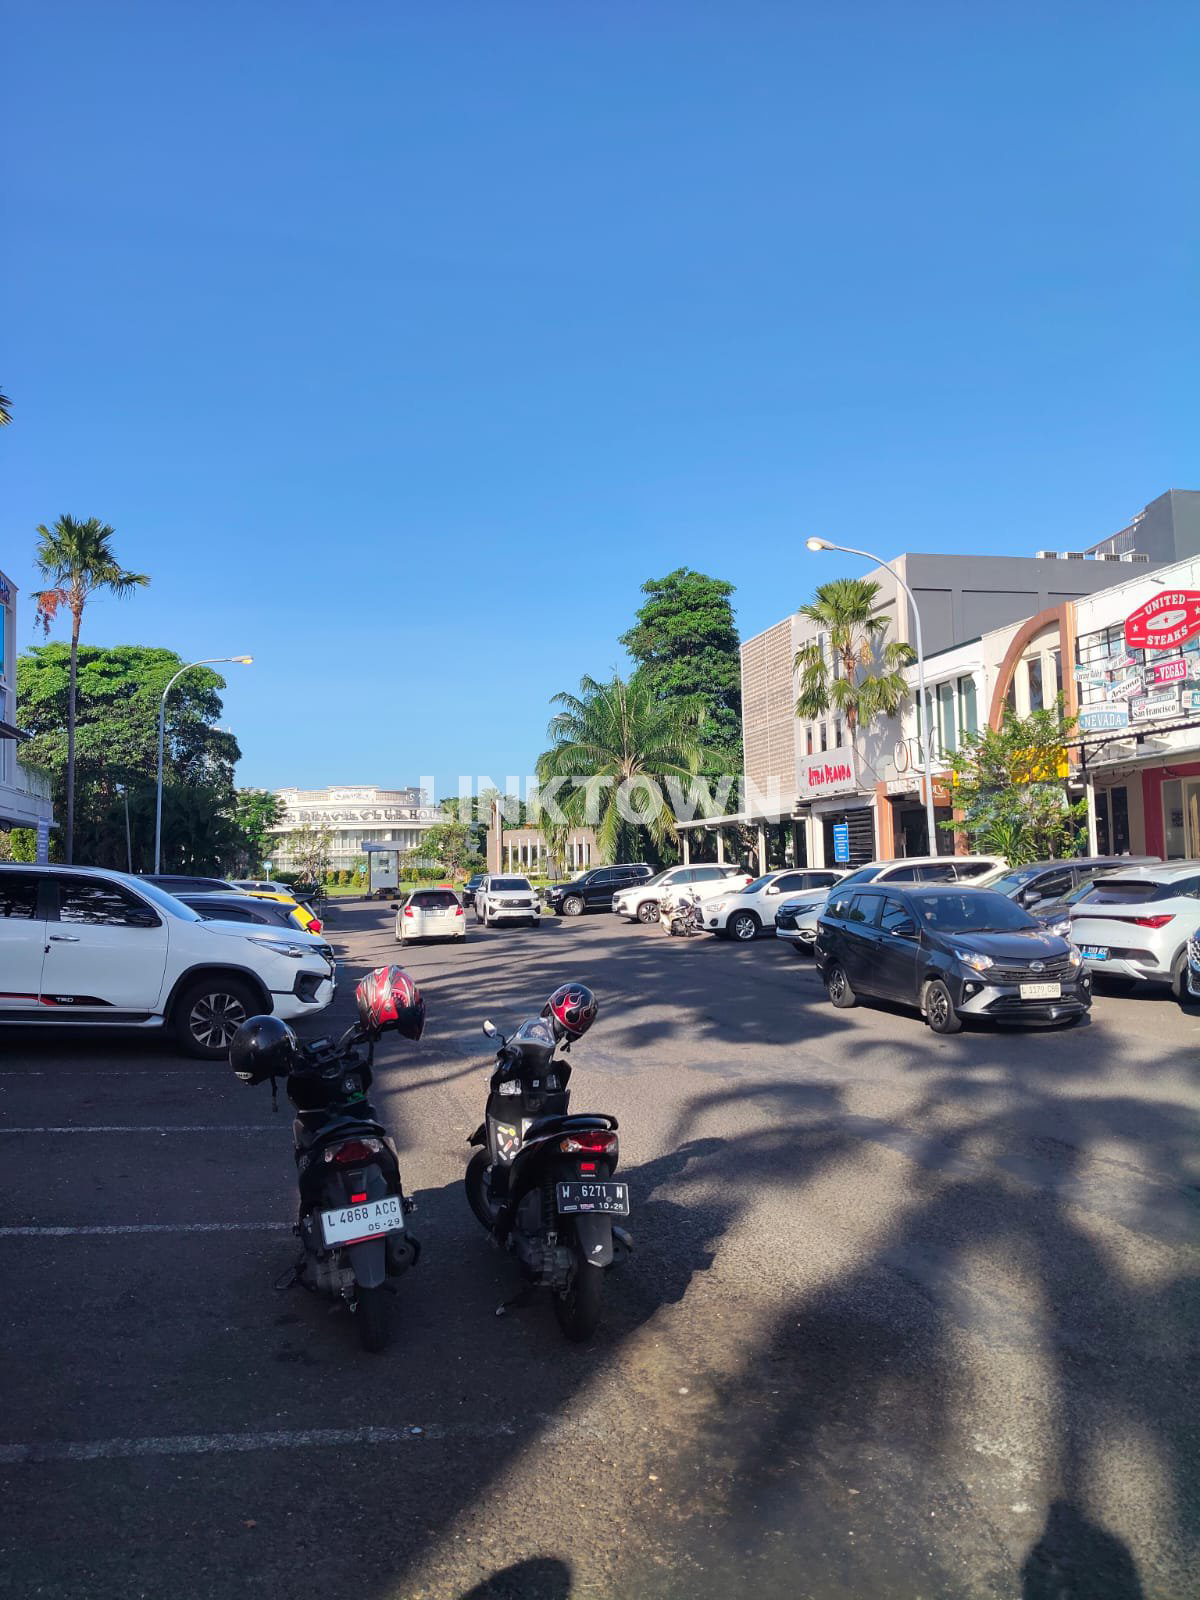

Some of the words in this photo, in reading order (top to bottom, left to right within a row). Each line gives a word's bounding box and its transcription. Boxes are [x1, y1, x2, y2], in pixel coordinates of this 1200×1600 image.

[1144, 594, 1186, 615] UNITED
[1147, 625, 1188, 645] STEAKS
[1160, 662, 1185, 681] VEGAS
[1084, 713, 1122, 728] NEVADA
[562, 1185, 570, 1198] W
[581, 1185, 607, 1198] 6271
[327, 1215, 335, 1226] L
[340, 1207, 369, 1224] 4868
